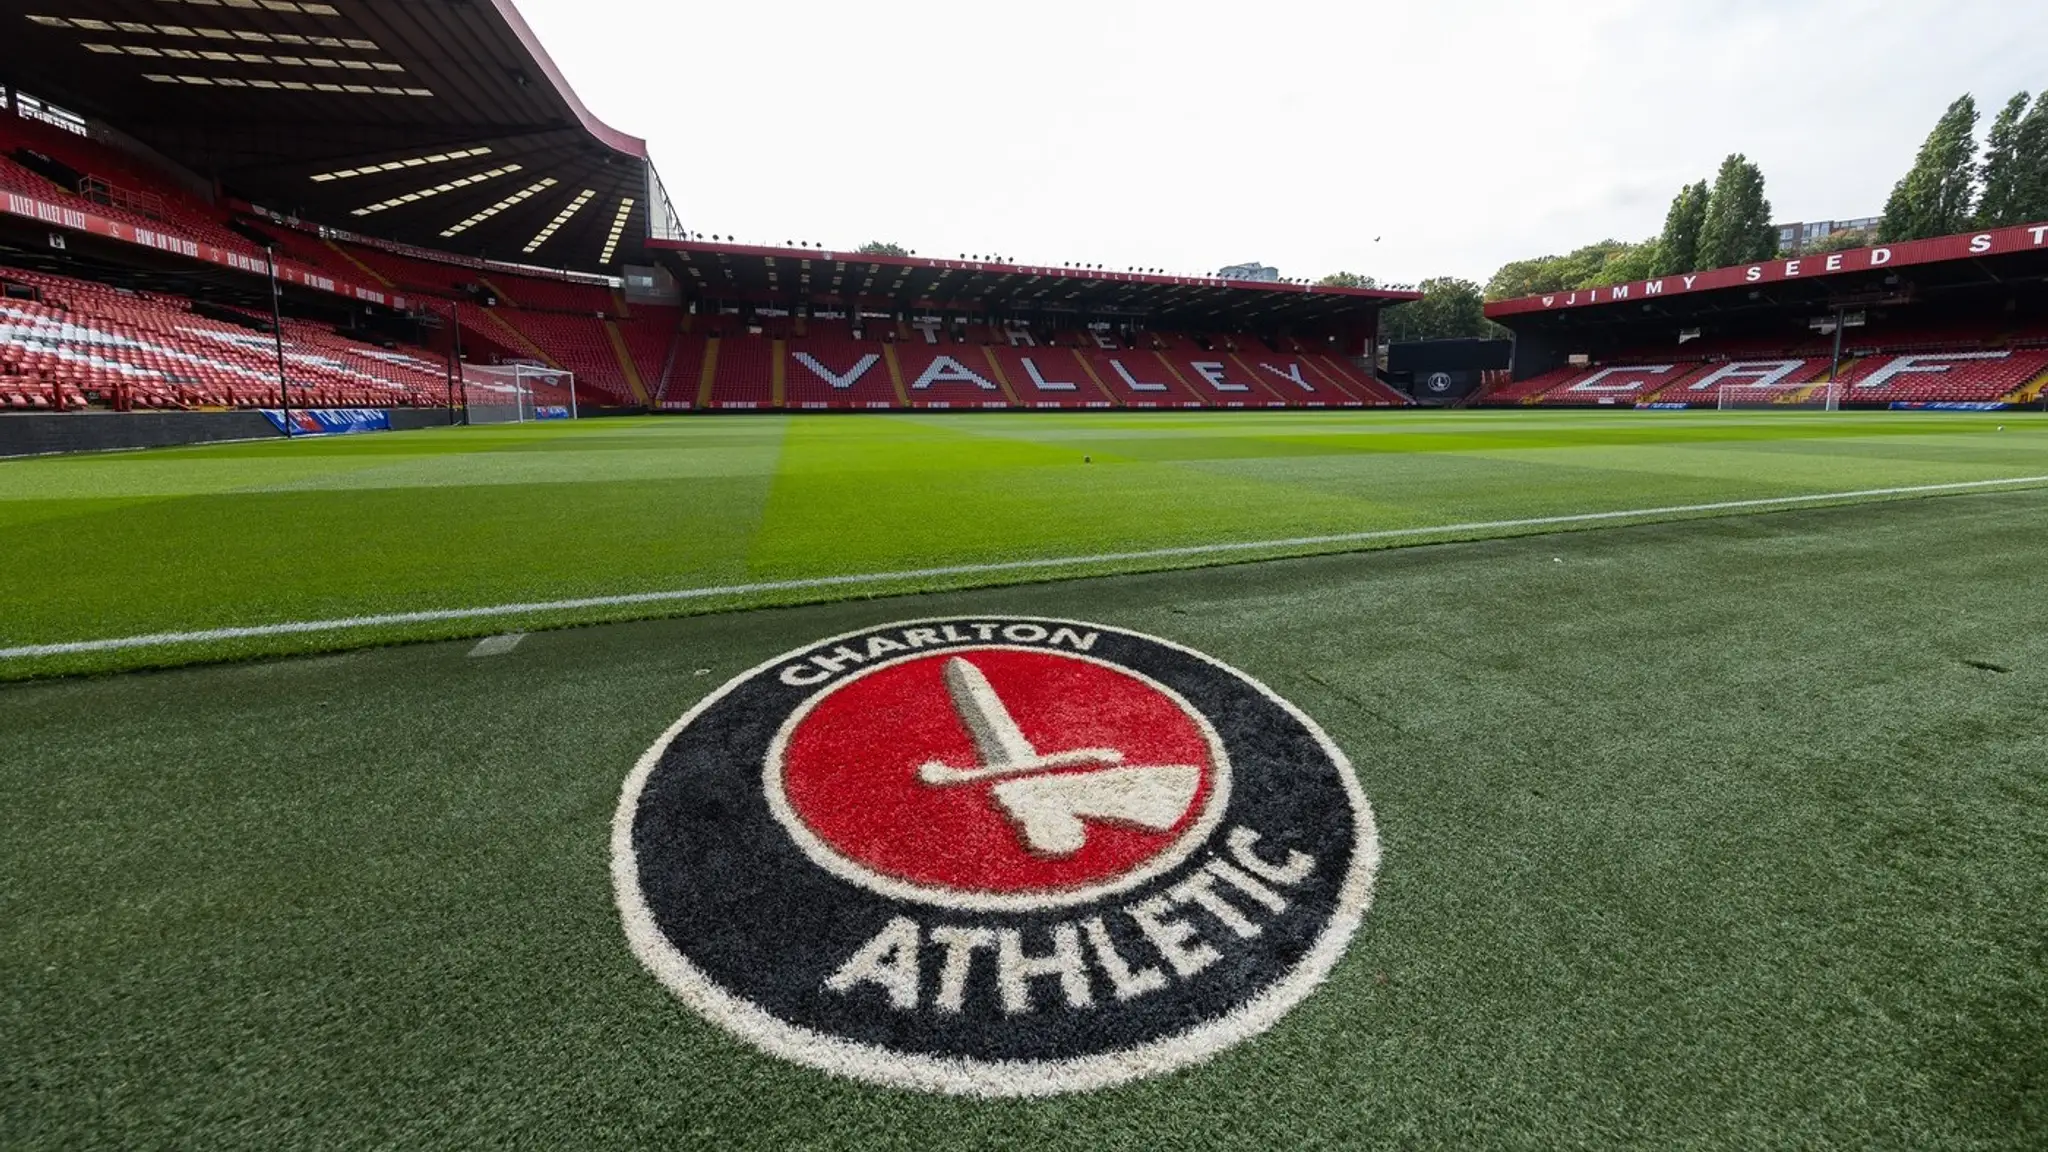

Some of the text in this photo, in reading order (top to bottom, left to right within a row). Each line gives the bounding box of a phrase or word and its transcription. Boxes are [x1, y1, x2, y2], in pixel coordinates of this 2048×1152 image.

[9, 194, 87, 230] ALLEZ ALLEZ ALLEZ
[929, 259, 1227, 287] ALAN CURBISHLEY STAND
[1566, 276, 1696, 305] JIMMY
[1746, 248, 1892, 281] SEED
[913, 322, 1118, 349] THE
[792, 351, 1315, 392] VALLEY
[779, 622, 1099, 686] CHARLTON
[819, 824, 1316, 1014] ATHLETIC
